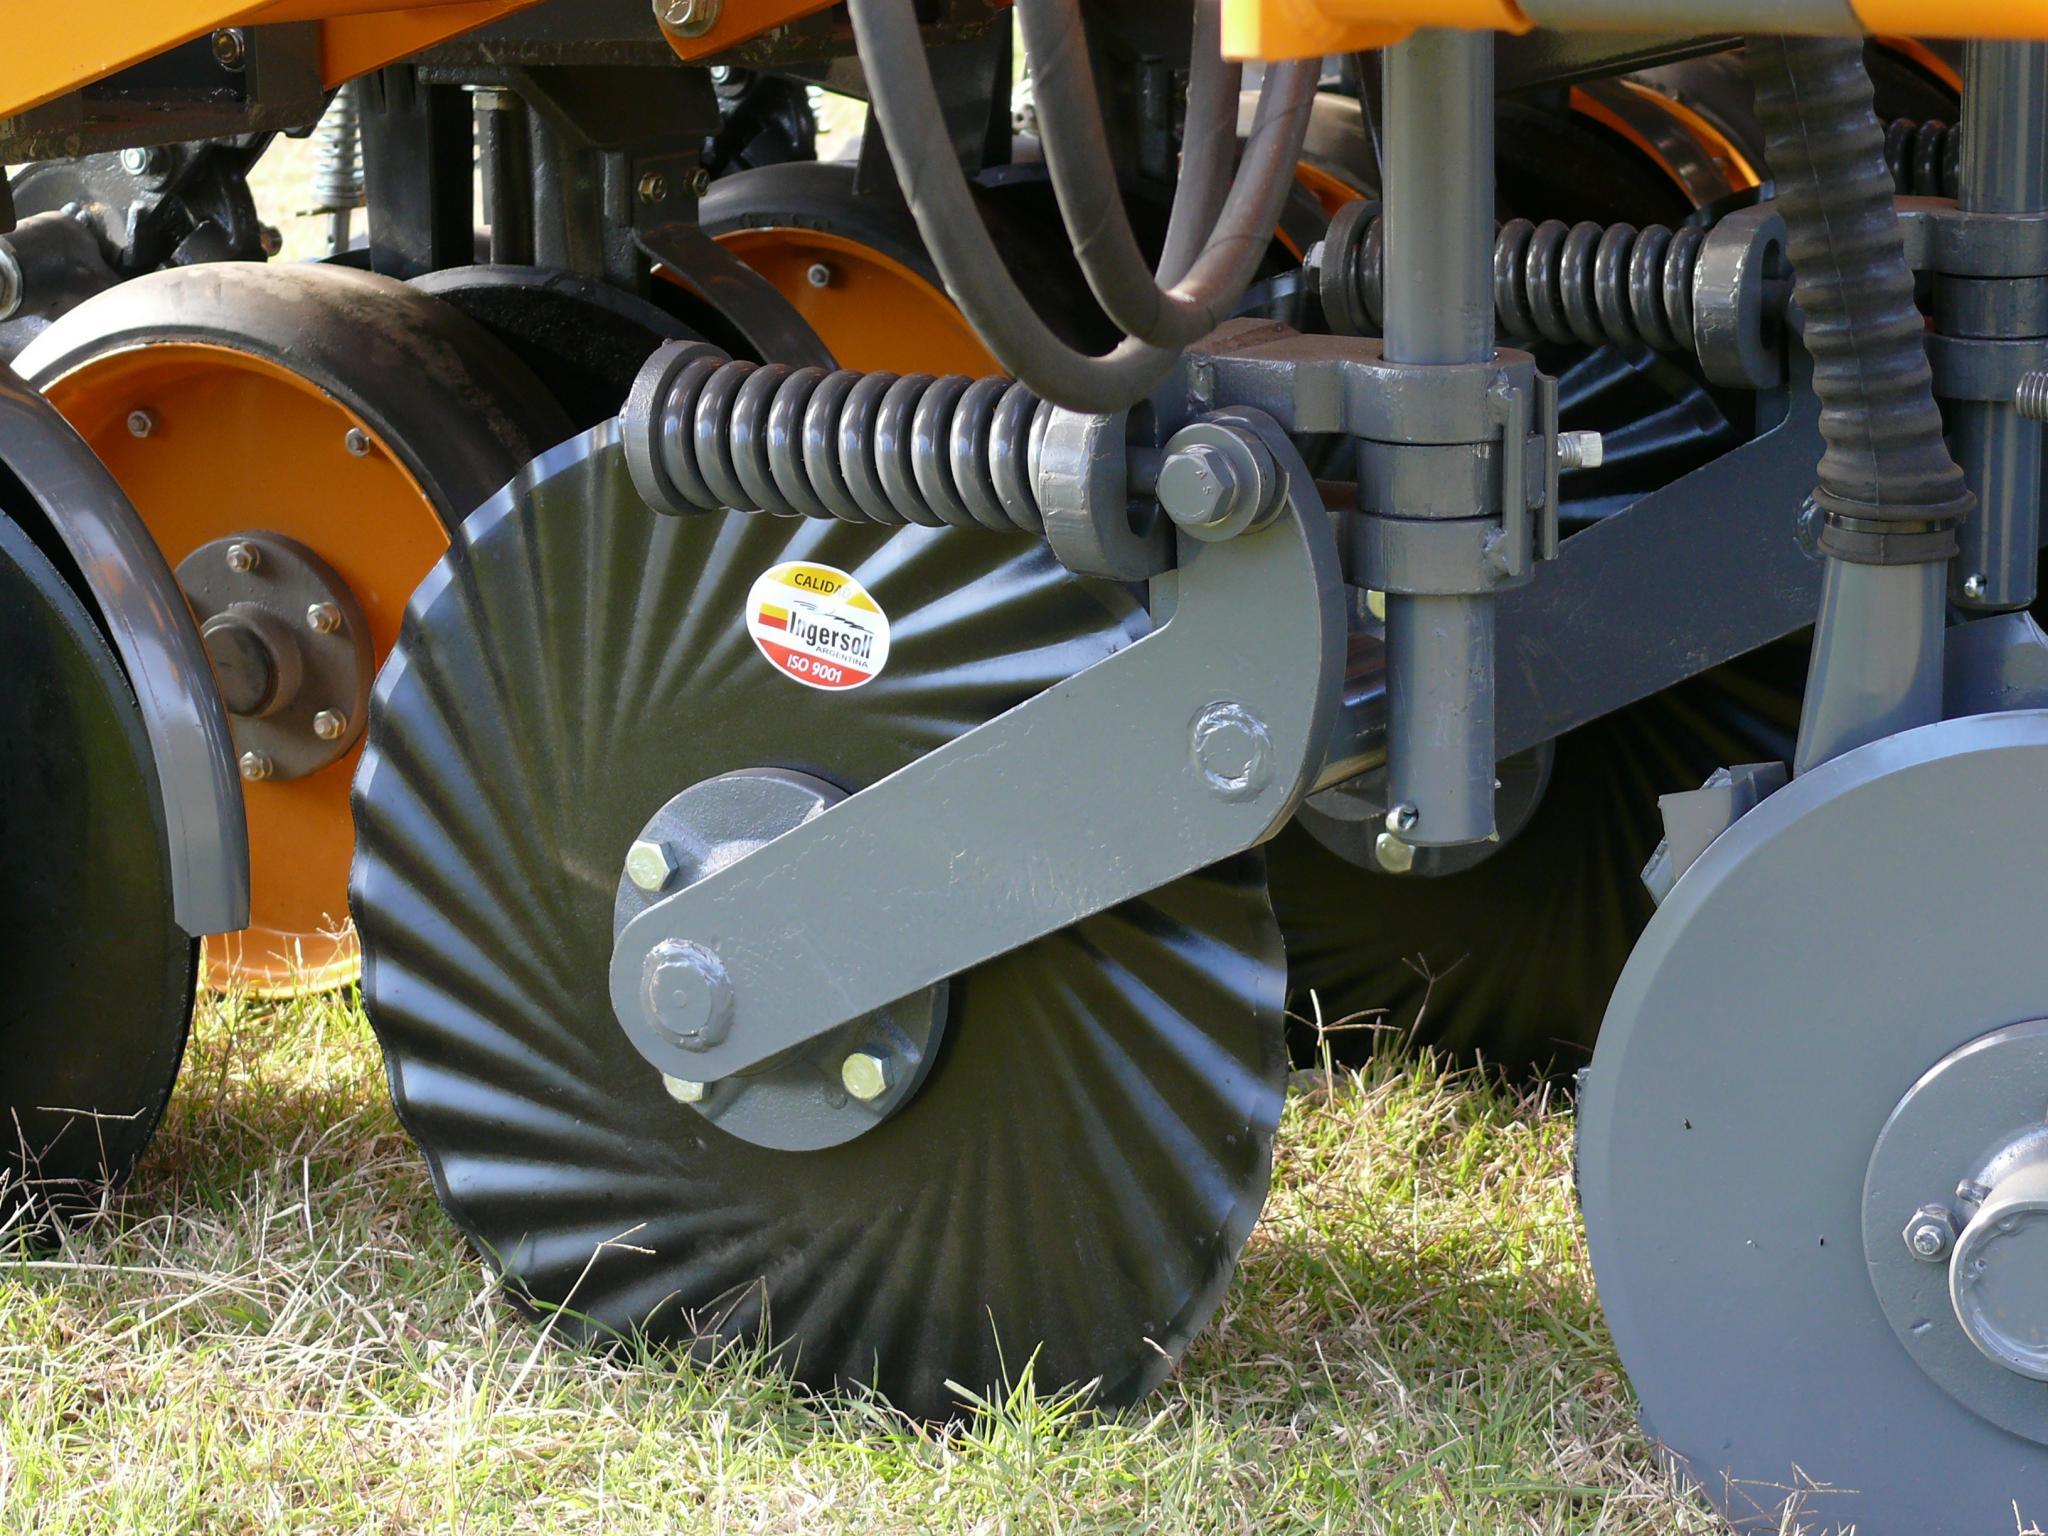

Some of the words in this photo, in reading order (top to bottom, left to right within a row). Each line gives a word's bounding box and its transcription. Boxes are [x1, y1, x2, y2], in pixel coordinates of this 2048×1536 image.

[789, 611, 873, 659] Ingersoll
[786, 654, 809, 671] ISO
[811, 661, 842, 683] 9001
[815, 646, 869, 668] ARGENTINA
